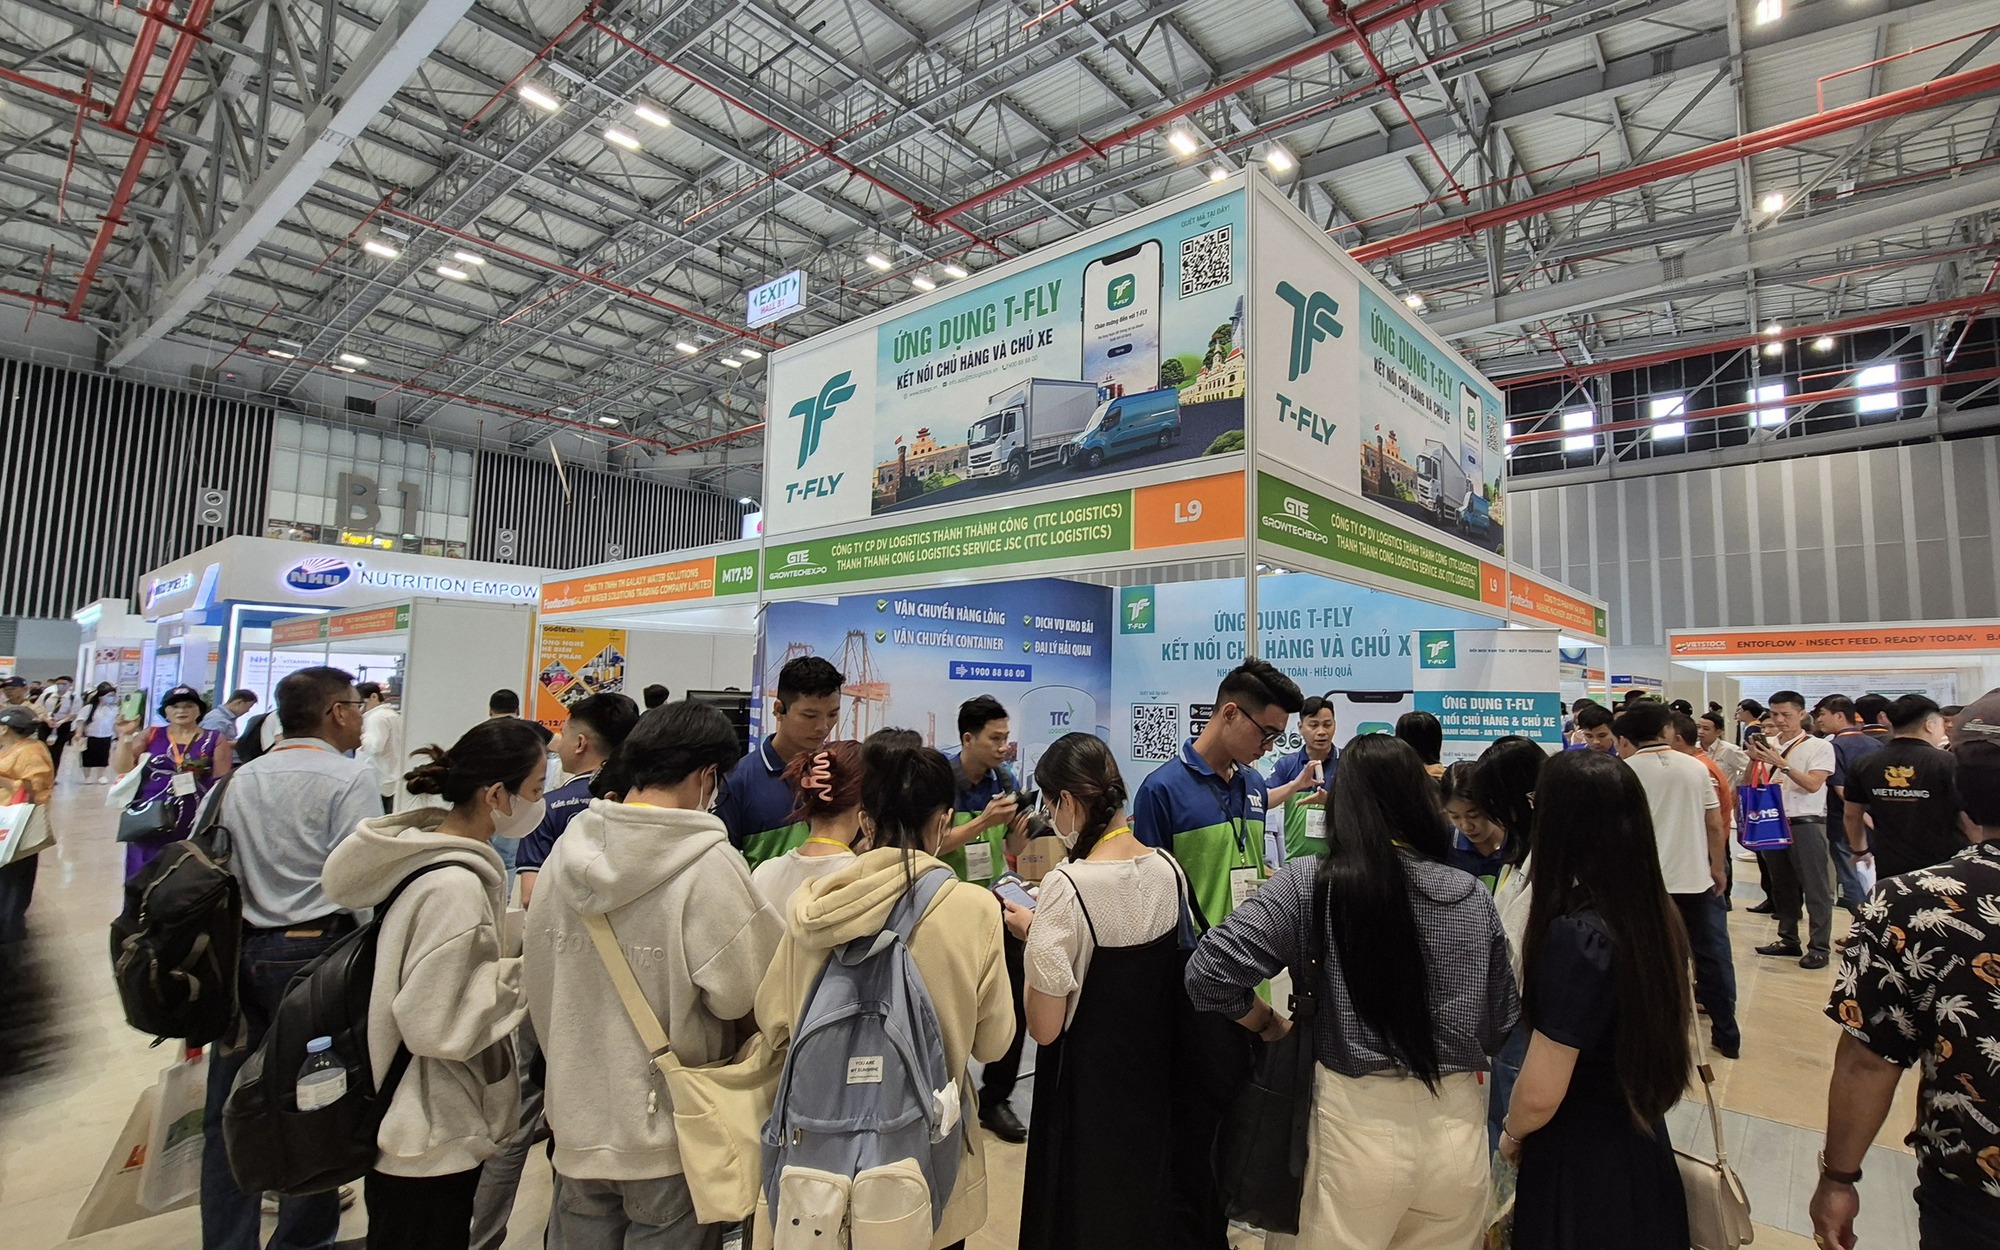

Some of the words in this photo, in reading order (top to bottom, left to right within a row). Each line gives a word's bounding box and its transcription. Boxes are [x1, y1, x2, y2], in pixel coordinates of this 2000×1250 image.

[760, 278, 790, 306] EXIT
[760, 303, 776, 314] HALL
[894, 325, 932, 364] ỨNG
[939, 303, 996, 350] DỤNG
[1004, 278, 1062, 327] T-FLY
[896, 367, 915, 390] KẾT
[916, 359, 934, 384] NỐI
[936, 353, 957, 378] CHỦ
[960, 348, 989, 371] HÀNG
[993, 340, 1006, 361] VÀ
[1010, 328, 1033, 356] CHỦ
[1038, 328, 1053, 348] XE
[1370, 308, 1395, 357] ỨNG
[1399, 335, 1427, 382] DỤNG
[1430, 361, 1453, 401] T-FLY
[1276, 392, 1337, 446] T-FLY
[786, 472, 845, 503] T-FLY
[336, 472, 420, 533] B1
[1174, 500, 1202, 524] L9
[1284, 496, 1309, 521] GTE
[832, 543, 852, 557] CÔNG
[853, 542, 864, 554] TY
[864, 540, 875, 552] CP
[877, 539, 889, 550] DV
[890, 532, 930, 548] LOGISTICS
[932, 526, 962, 542] THÀNH
[964, 522, 997, 539] THÀNH
[1000, 517, 1028, 533] CÔNG
[1034, 512, 1057, 530] (TTC
[1060, 503, 1122, 525] LOGISTICS)
[1262, 516, 1328, 545] GROWTECHEXPO
[1331, 512, 1350, 532] CÔNG
[1350, 520, 1358, 534] TY
[1359, 524, 1368, 538] CP
[1368, 527, 1376, 541] DV
[1376, 530, 1402, 551] LOGISTICS
[786, 550, 810, 564] GTE
[836, 557, 862, 571] THANH
[864, 554, 890, 568] THANH
[892, 552, 916, 564] CONG
[916, 541, 960, 562] LOGISTICS
[962, 538, 1002, 556] SERVICE
[1004, 536, 1022, 552] JSC
[1024, 532, 1048, 550] (TTC
[1050, 524, 1112, 545] LOGISTICS)
[1336, 534, 1358, 553] THANH
[1379, 548, 1394, 564] CONG
[1394, 554, 1419, 572] LOGISTICS
[290, 572, 340, 586] NHU
[360, 571, 466, 592] NUTRITION
[597, 581, 603, 591] TY
[626, 576, 647, 588] GALAXY
[648, 573, 665, 584] WATER
[666, 568, 698, 582] SOLUTIONS
[722, 566, 754, 584] M17,19
[769, 566, 828, 580] GROWTECHEXPO
[592, 592, 607, 603] WATER
[607, 589, 635, 602] SOLUTIONS
[635, 586, 660, 599] TRADING
[660, 582, 688, 596] COMPANY
[688, 578, 712, 592] LIMITED
[1489, 578, 1498, 592] L9
[894, 598, 916, 619] VẬN
[917, 602, 954, 620] CHUYỂN
[956, 605, 982, 623] HÀNG
[1307, 606, 1354, 628] T-FLY
[1035, 616, 1053, 632] DỊCH
[1054, 618, 1064, 634] VỤ
[1066, 620, 1080, 632] KHO
[1127, 622, 1148, 630] T-FLY
[894, 627, 914, 648] VẬN
[916, 629, 954, 647] CHUYỂN
[956, 634, 1004, 650] CONTAINER
[1035, 641, 1048, 656] ĐẠI
[1049, 640, 1058, 654] LÝ
[1058, 640, 1070, 655] HẢI
[1072, 645, 1092, 656] QUAN
[1162, 636, 1189, 661] KẾT
[1194, 634, 1220, 660] NỐI
[1266, 635, 1314, 659] HÀNG
[1320, 633, 1344, 658] VÀ
[1351, 628, 1390, 658] CHỦ
[1737, 640, 1796, 648] ENTOFLOW
[1806, 638, 1844, 646] INSECT
[1848, 637, 1881, 645] FEED.
[1884, 636, 1926, 644] READY
[1929, 634, 1976, 642] TODAY.
[970, 667, 990, 676] 1900
[992, 668, 1002, 677] 88
[1004, 669, 1013, 677] 88
[1016, 669, 1025, 678] 00
[1287, 665, 1308, 677] TOÀN
[1314, 665, 1333, 680] HIỆU
[1335, 664, 1353, 677] QUẢ
[1442, 694, 1467, 710] ỨNG
[1470, 698, 1502, 712] DỤNG
[1505, 698, 1535, 710] T-FLY
[1050, 712, 1070, 726] TTC
[1443, 712, 1460, 725] NỐI
[1462, 713, 1480, 726] CHỦ
[1483, 714, 1509, 726] HÀNG
[1512, 717, 1519, 726] &
[1522, 714, 1540, 727] CHỦ
[1543, 717, 1556, 727] XE
[1872, 788, 1930, 798] VIETHOANG
